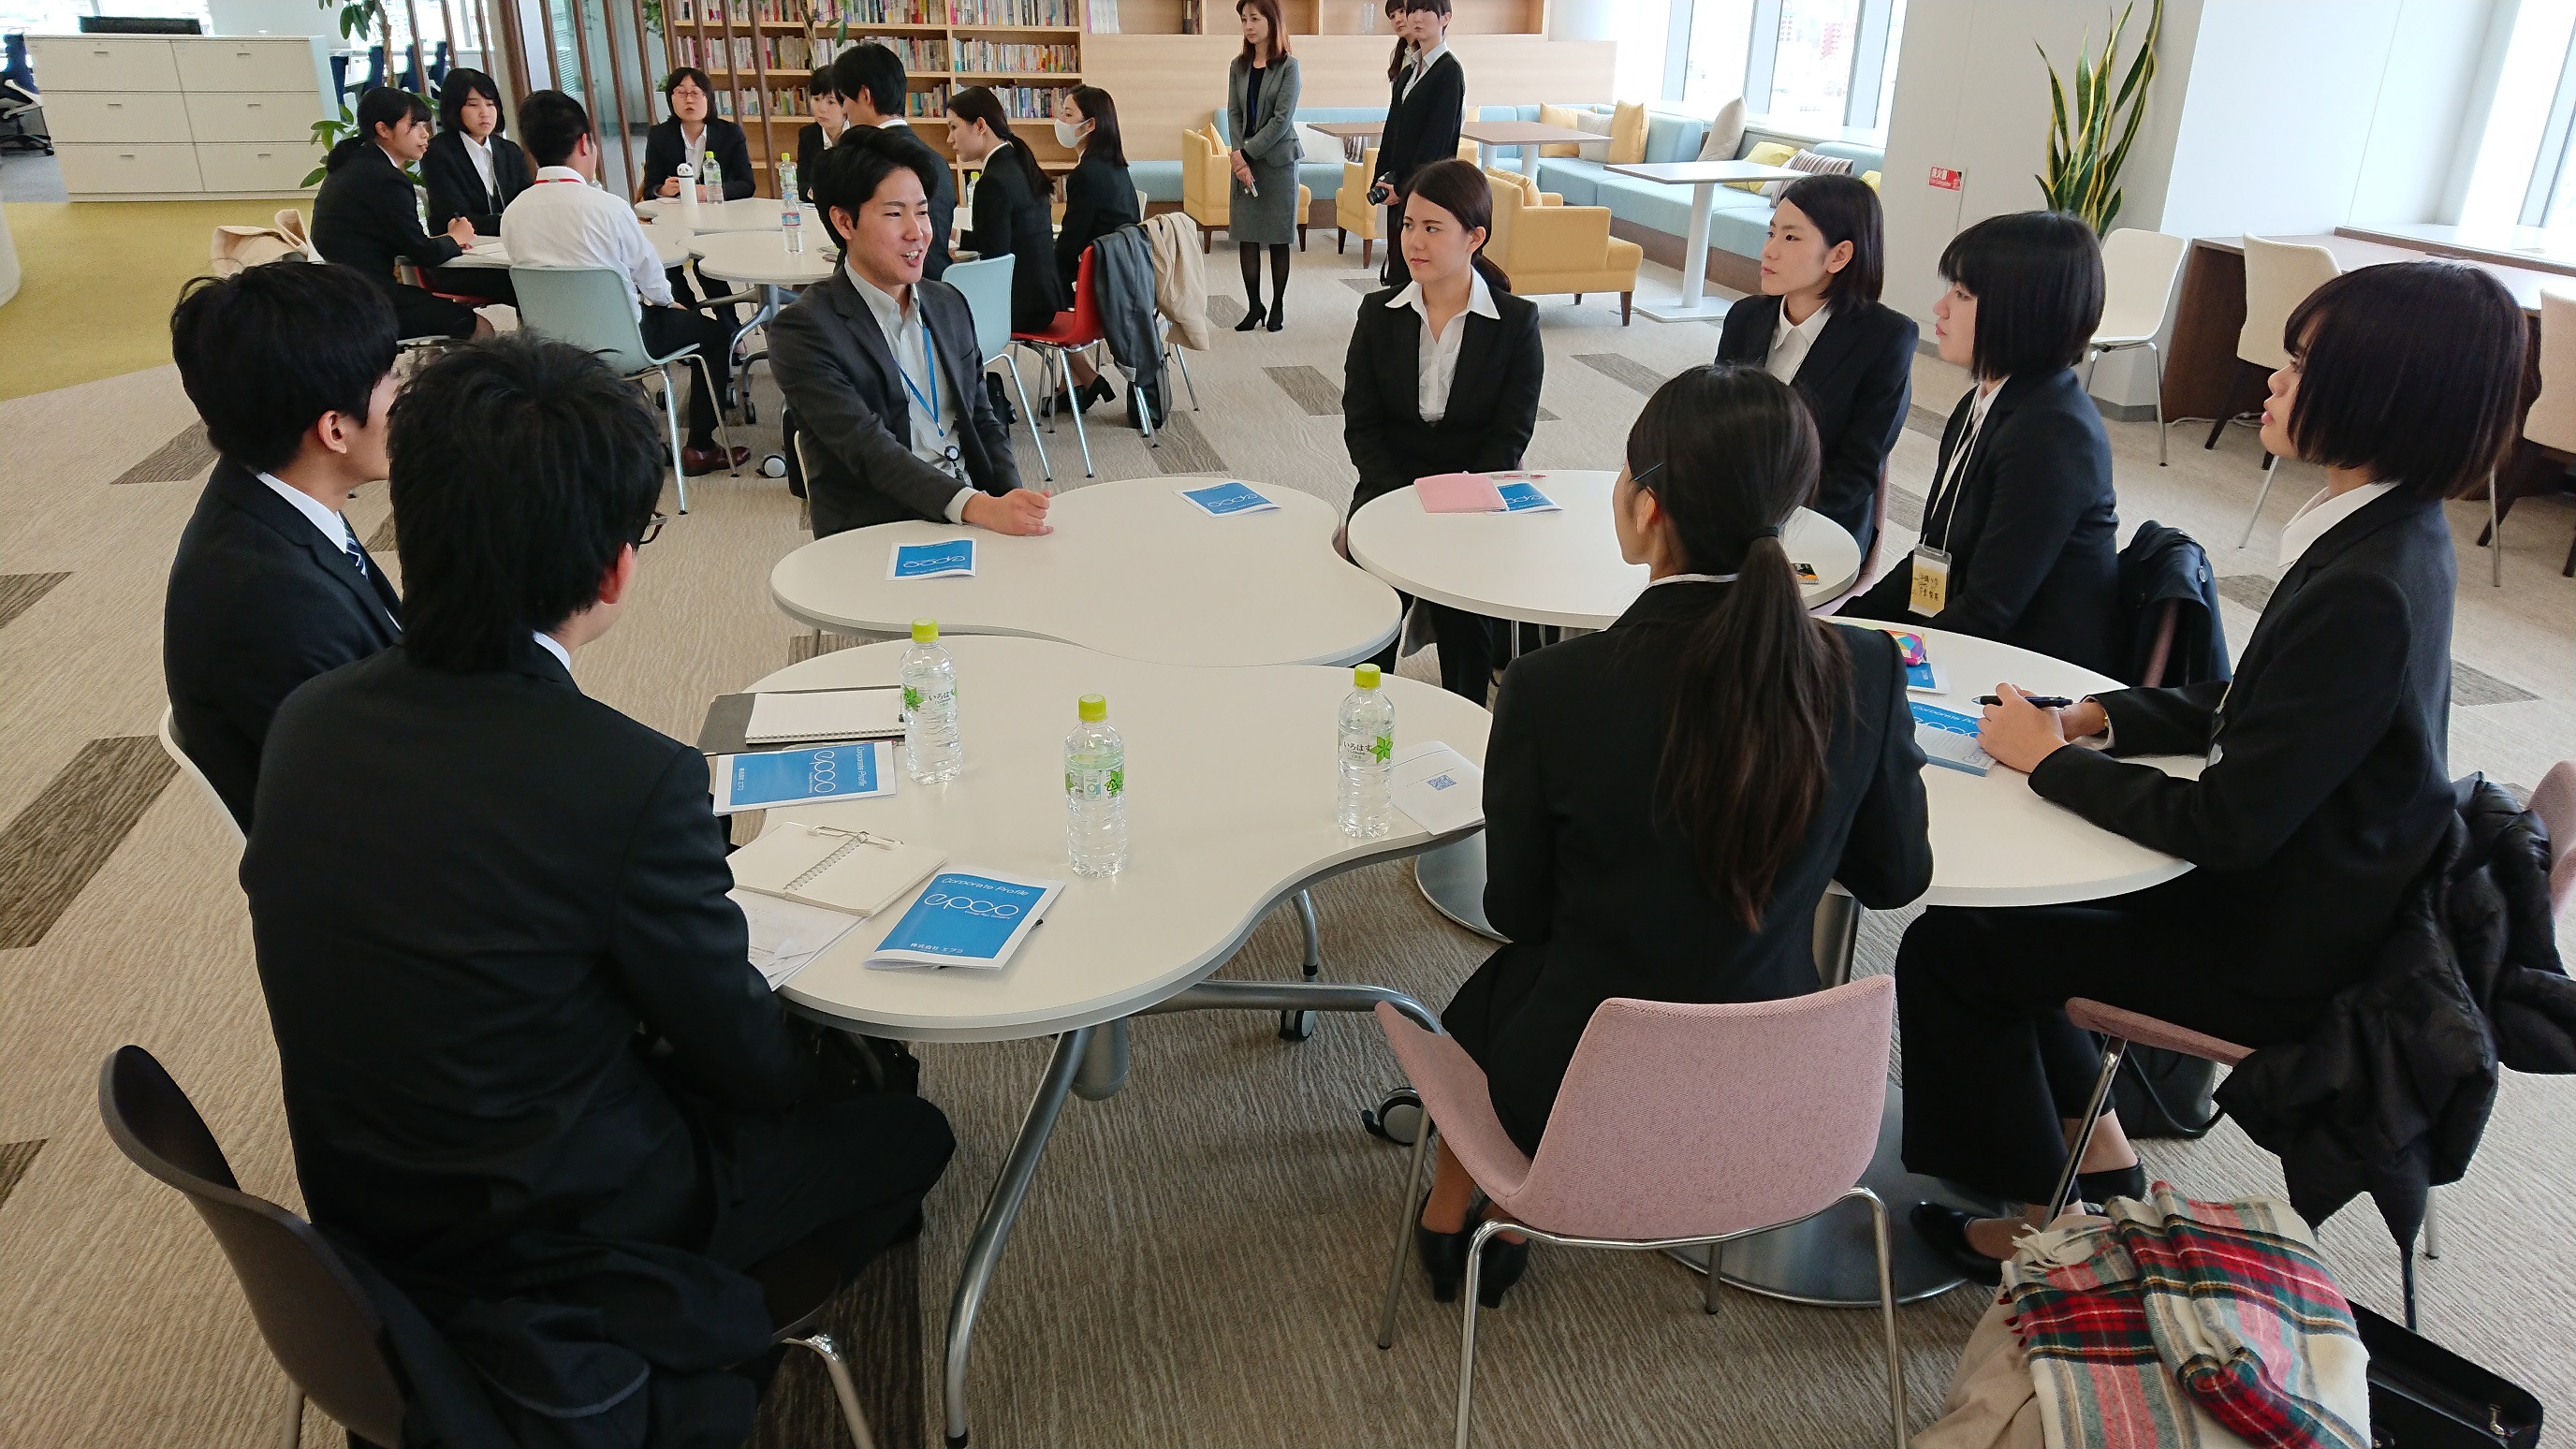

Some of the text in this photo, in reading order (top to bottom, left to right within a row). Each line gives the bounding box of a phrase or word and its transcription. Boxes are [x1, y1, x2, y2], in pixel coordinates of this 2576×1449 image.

[808, 750, 837, 794] epco
[941, 877, 1030, 898] Corporate Profile
[923, 893, 1020, 917] epco
